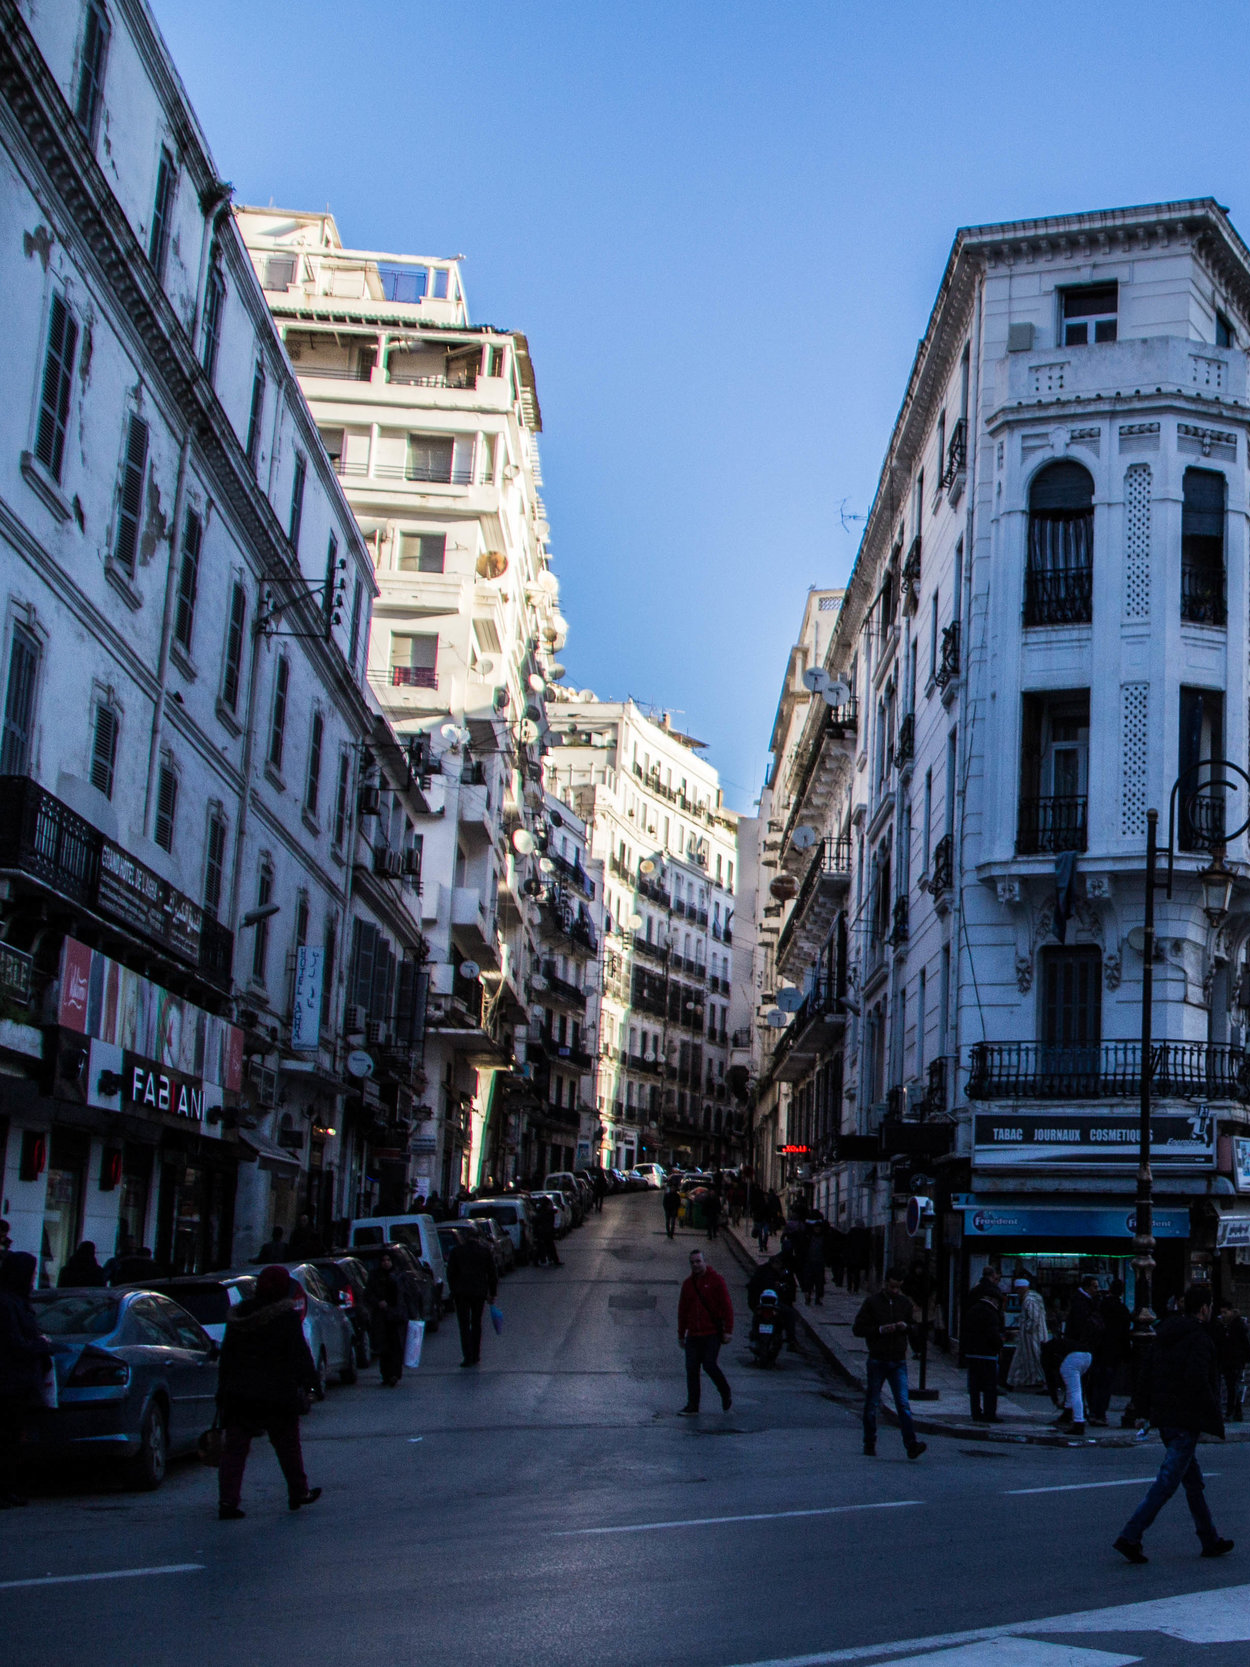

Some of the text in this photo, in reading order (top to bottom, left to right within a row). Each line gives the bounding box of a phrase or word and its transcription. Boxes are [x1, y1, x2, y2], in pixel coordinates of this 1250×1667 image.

[297, 948, 306, 995] HOTEL
[132, 1066, 206, 1121] FABIANI
[992, 1127, 1154, 1142] TABAC JOURNAUX COSMETIQUS
[974, 1216, 1018, 1226] Freedent
